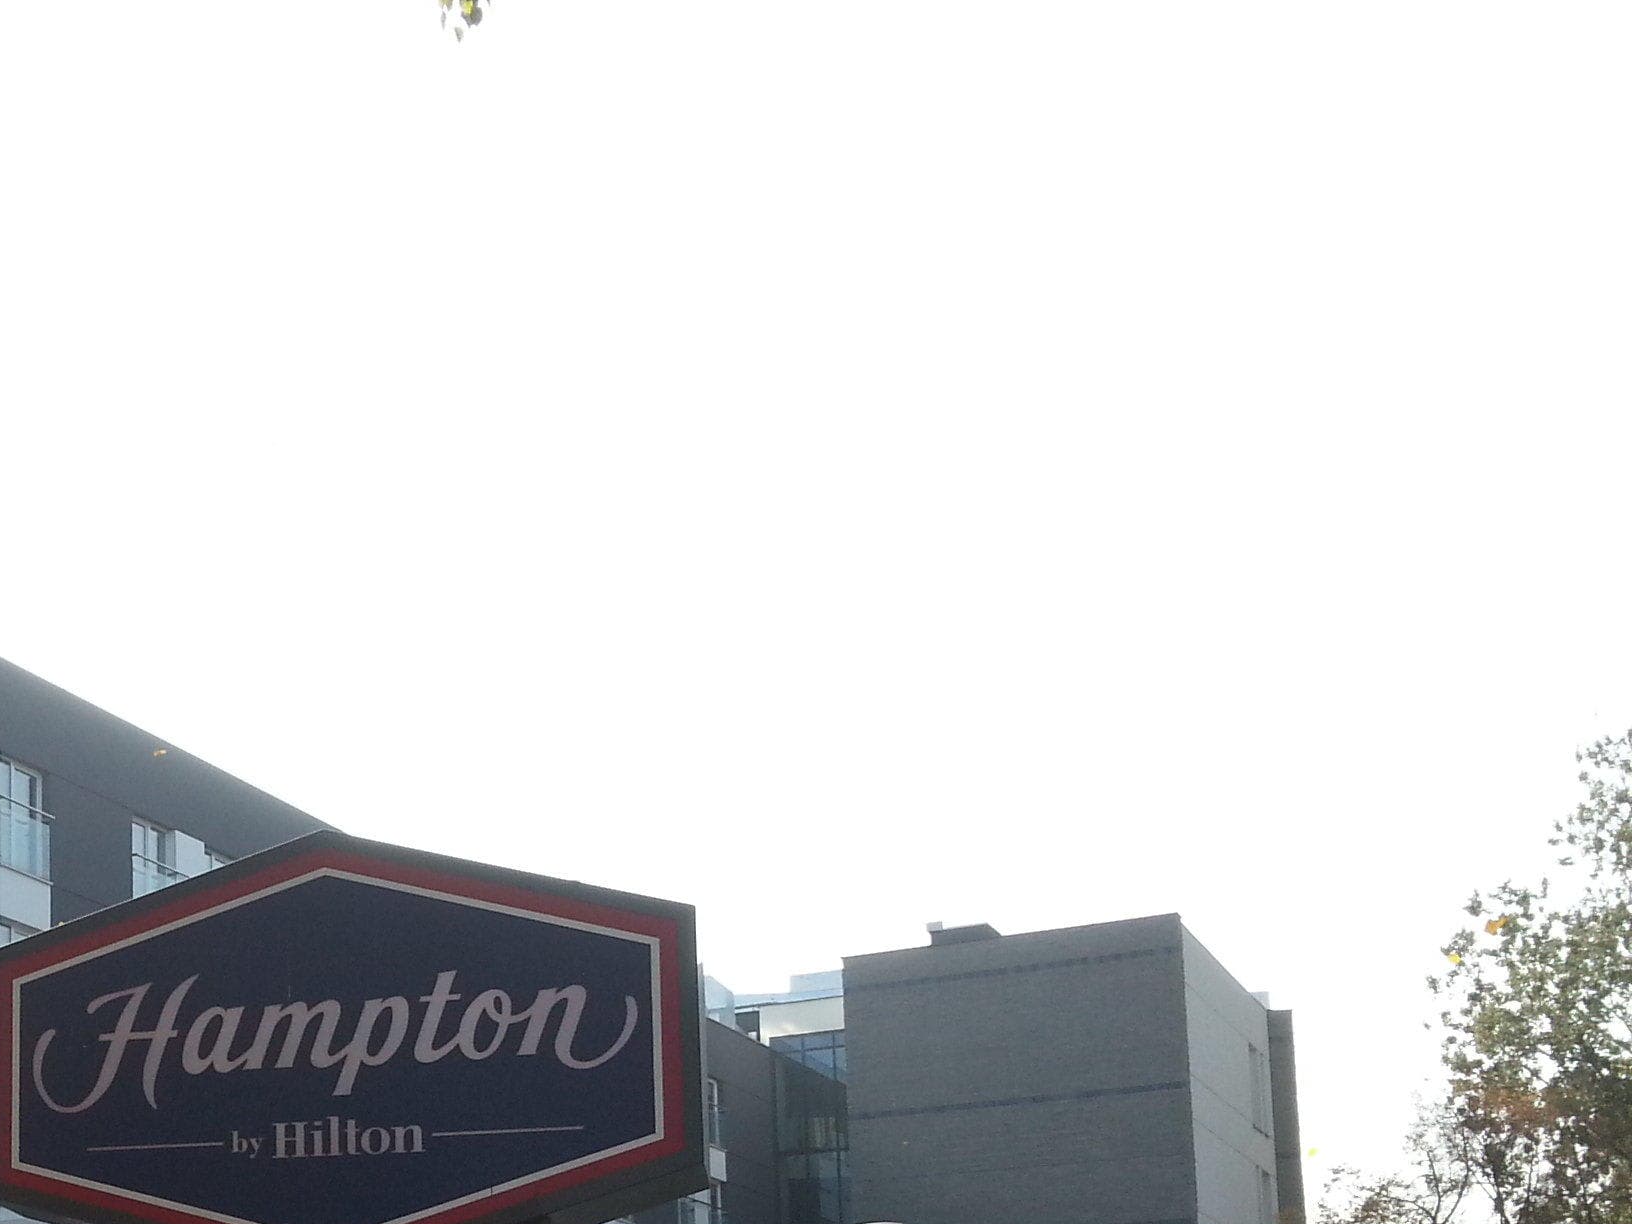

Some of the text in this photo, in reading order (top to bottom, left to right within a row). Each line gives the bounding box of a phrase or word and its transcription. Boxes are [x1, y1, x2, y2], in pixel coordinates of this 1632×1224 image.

[32, 970, 637, 1113] Hampton
[232, 1116, 426, 1159] by Hilton
